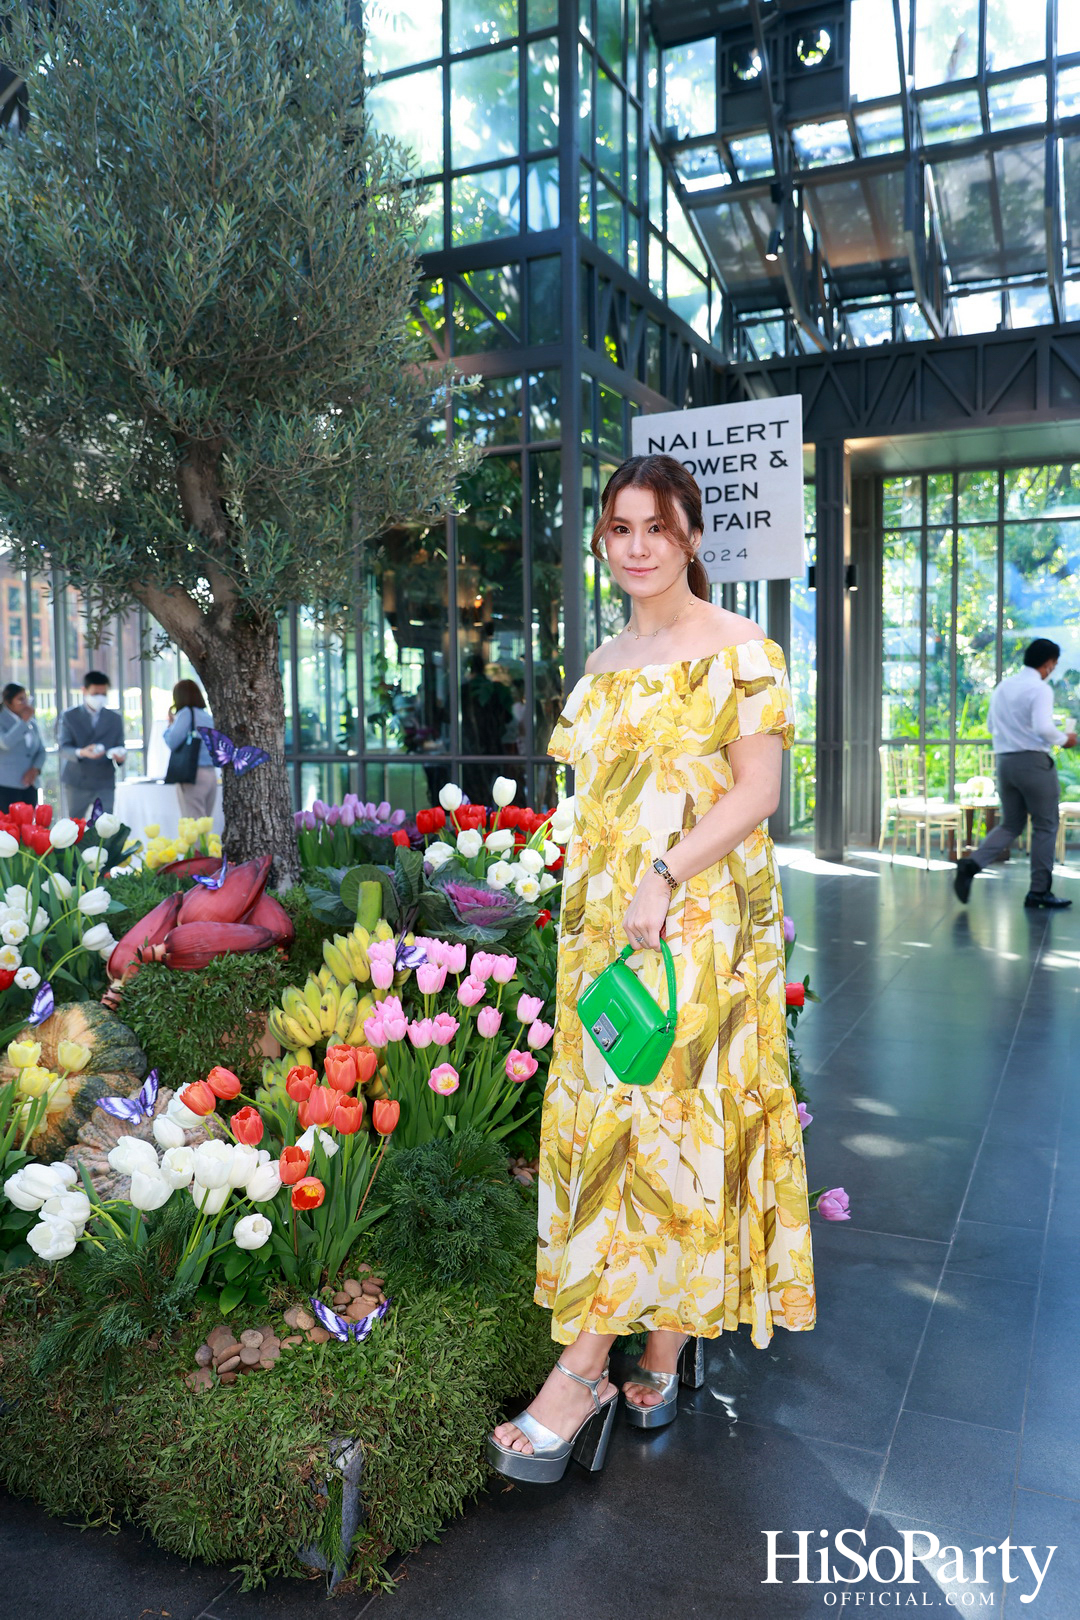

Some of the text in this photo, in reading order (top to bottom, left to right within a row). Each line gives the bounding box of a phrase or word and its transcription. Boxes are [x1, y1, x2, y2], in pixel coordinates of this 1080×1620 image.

[648, 420, 790, 454] NAI LERT
[682, 450, 789, 477] OWER &
[701, 482, 759, 504] DEN
[713, 510, 772, 533] FAIR
[703, 548, 748, 563] 024
